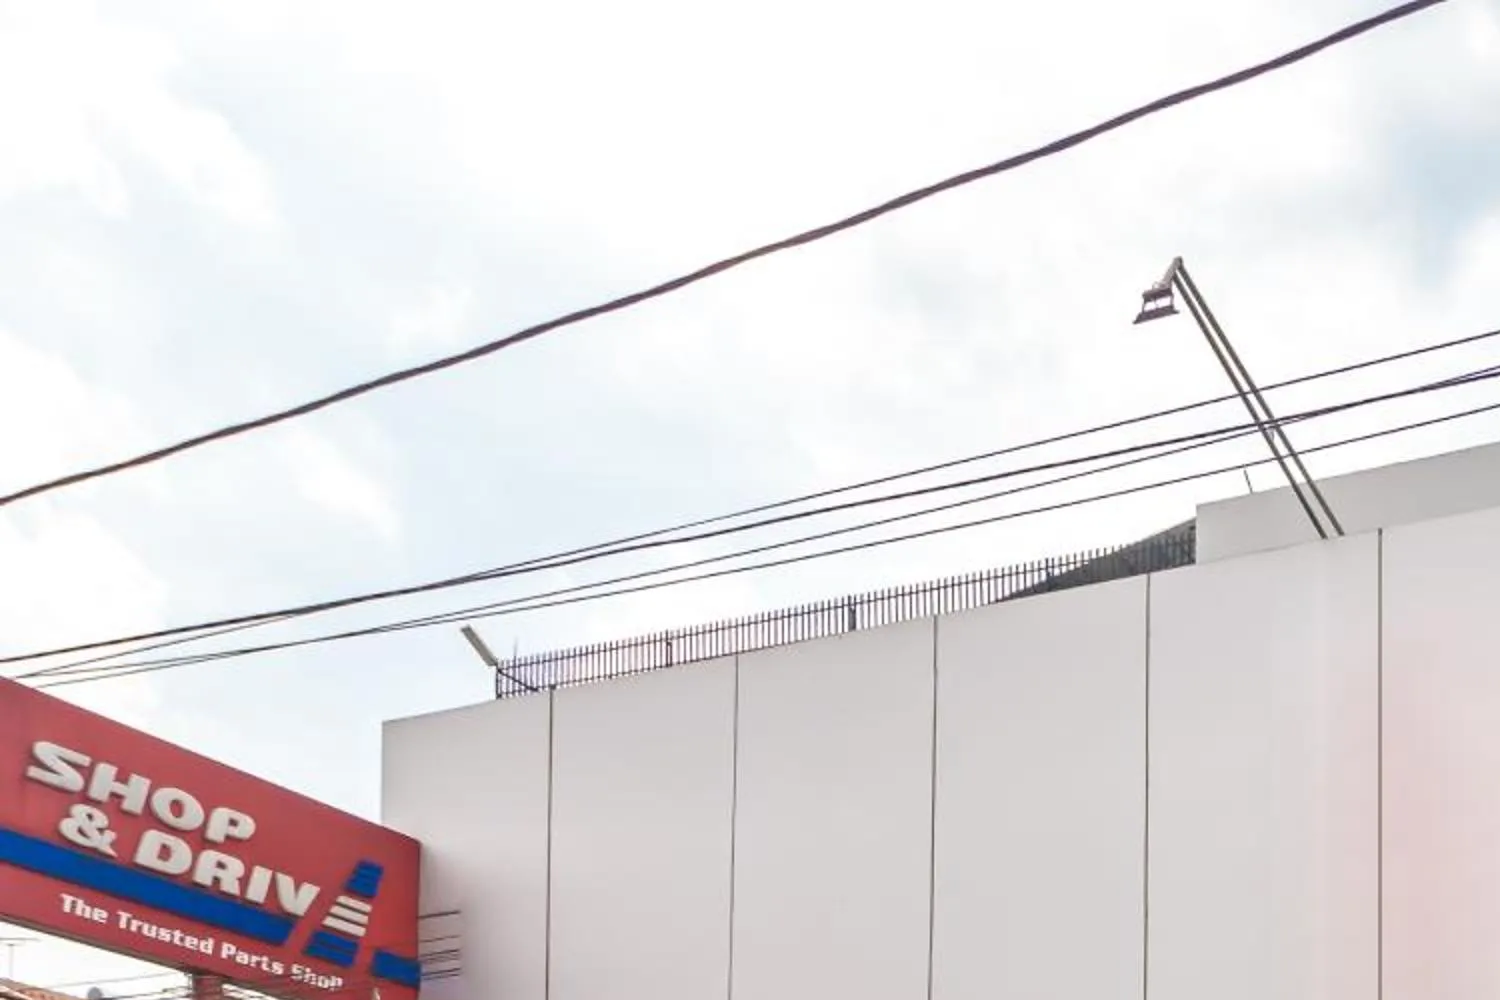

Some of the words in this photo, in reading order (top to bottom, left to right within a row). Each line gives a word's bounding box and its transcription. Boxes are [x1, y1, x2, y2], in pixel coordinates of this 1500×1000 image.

[26, 741, 256, 844] SHOP
[58, 803, 118, 857] &
[60, 893, 108, 924] The
[116, 911, 213, 955] Trusted
[220, 942, 284, 975] Parts
